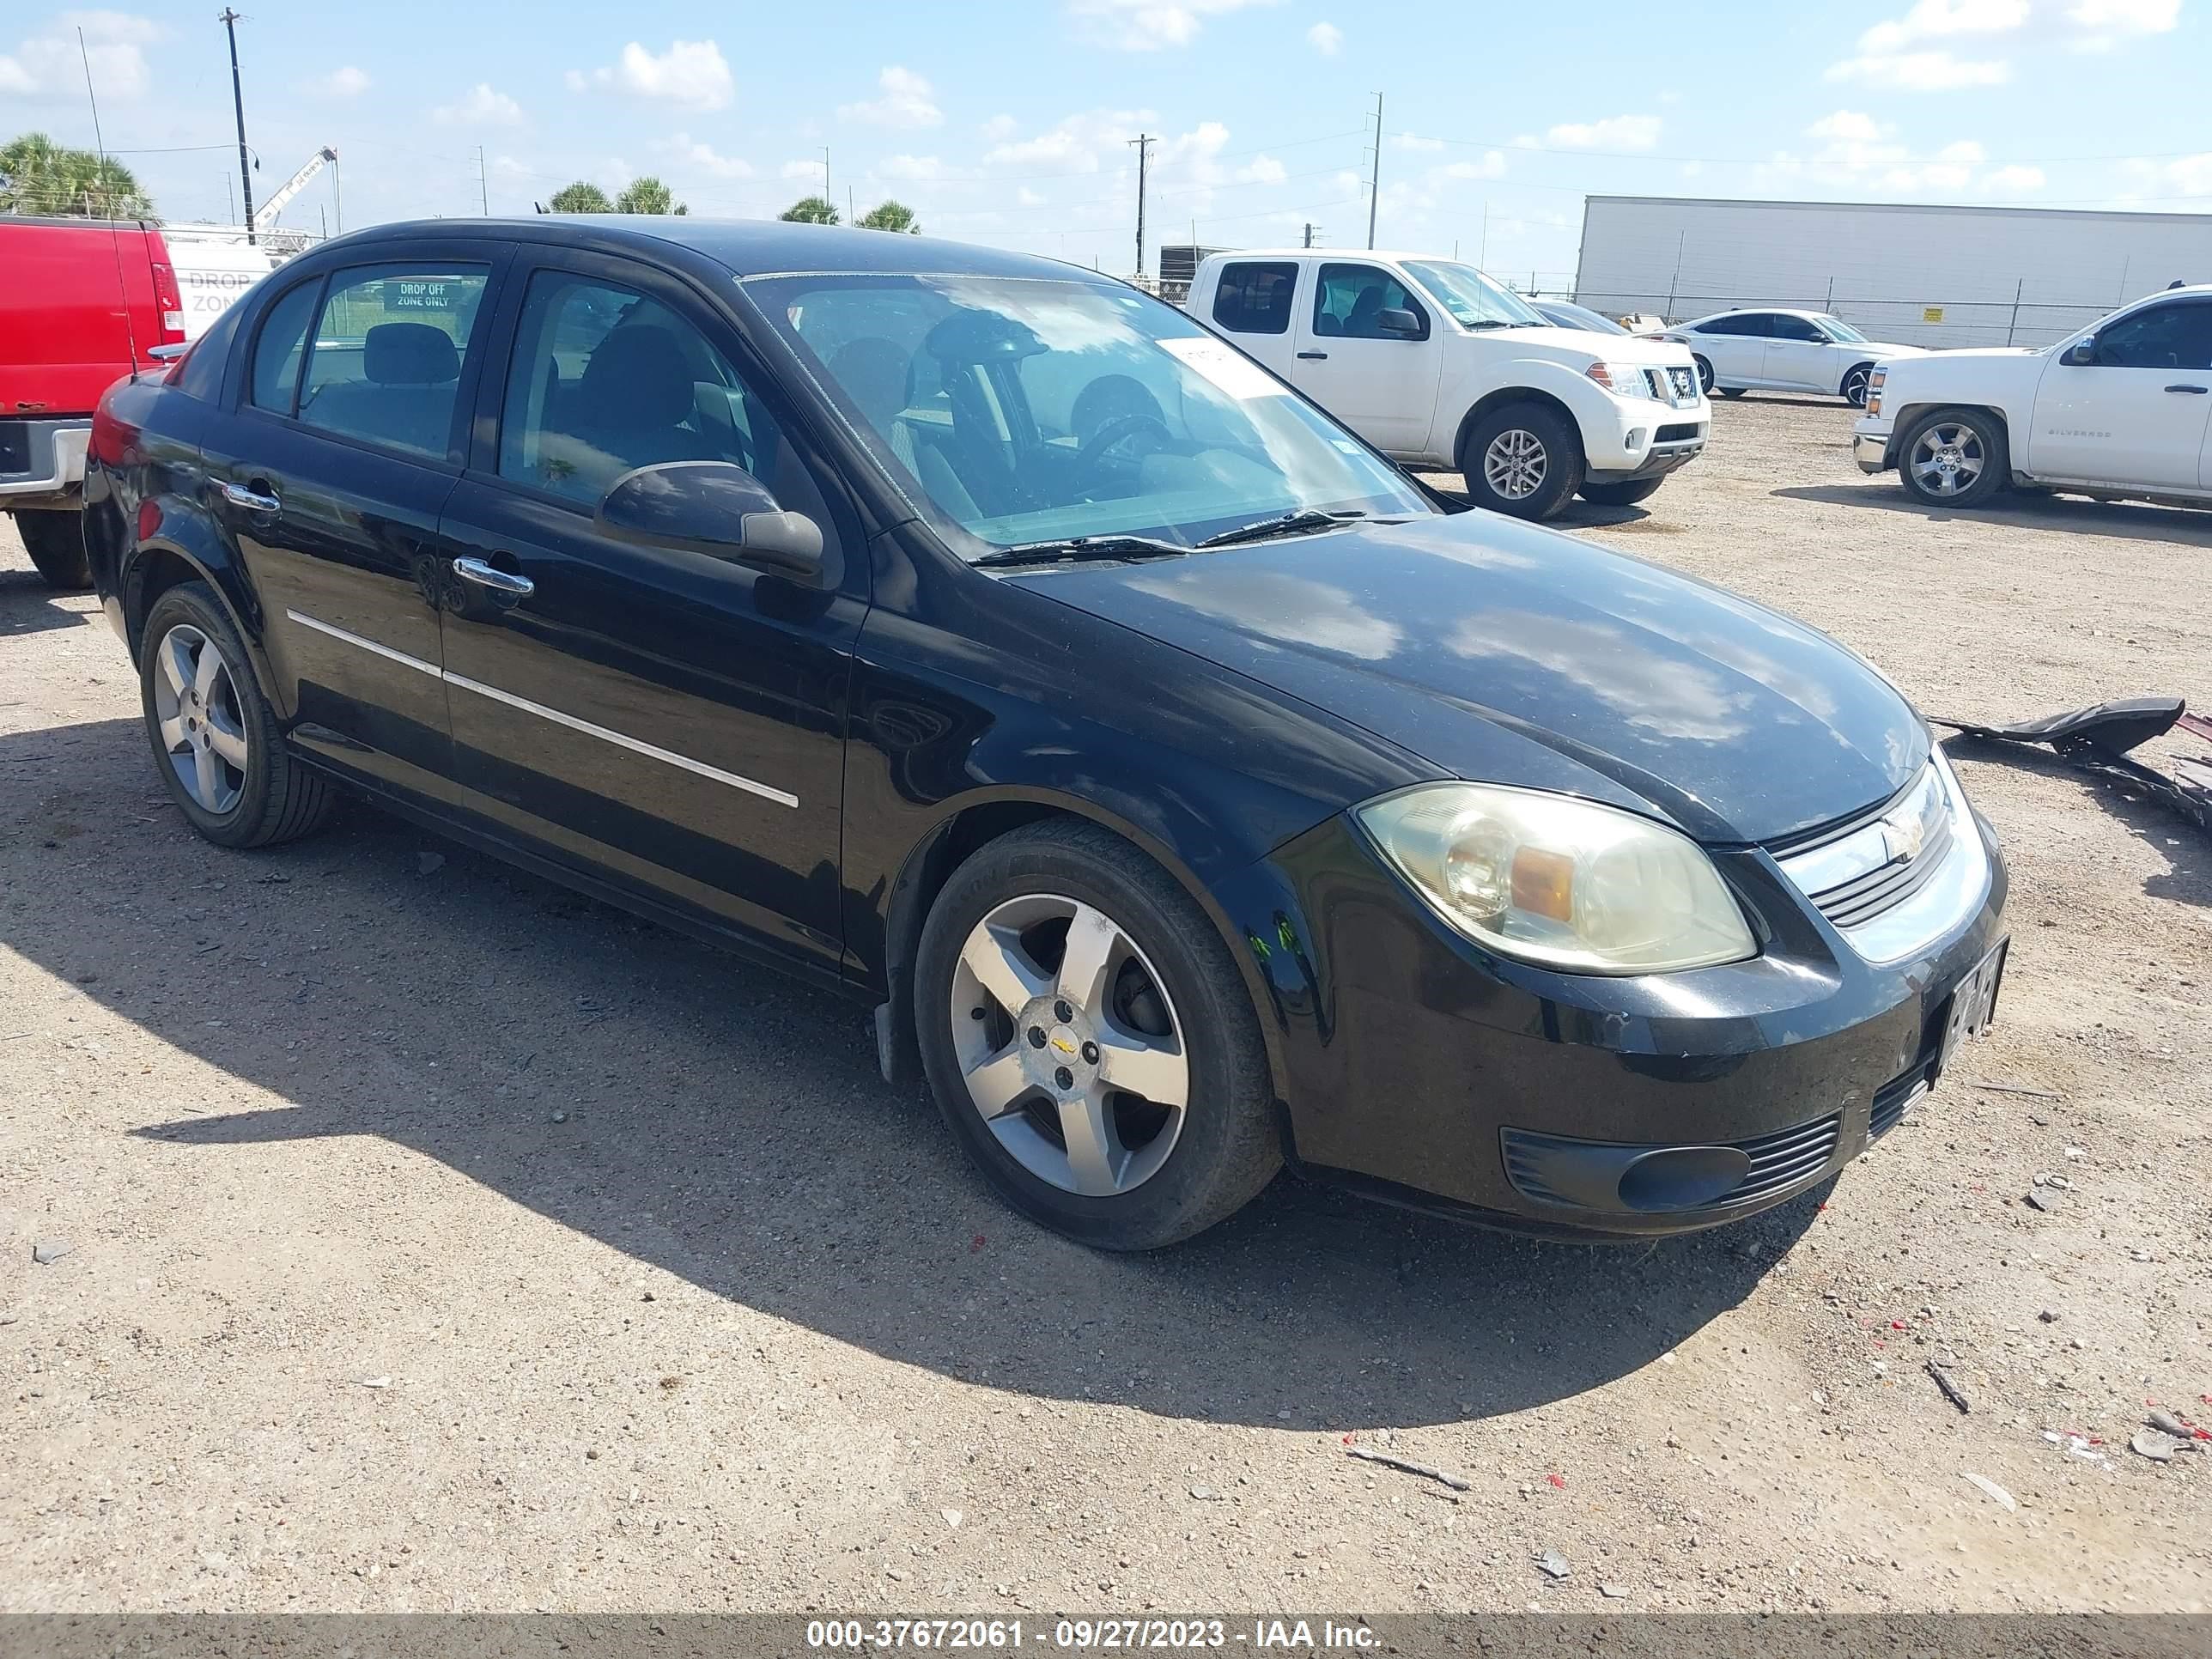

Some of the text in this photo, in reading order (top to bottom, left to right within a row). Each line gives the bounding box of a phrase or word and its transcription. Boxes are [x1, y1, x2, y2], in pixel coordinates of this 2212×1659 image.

[190, 272, 250, 289] DROP
[400, 283, 445, 295] DROP OFF
[398, 296, 449, 307] ZONE ONLY
[2047, 428, 2112, 438] SILVERADO
